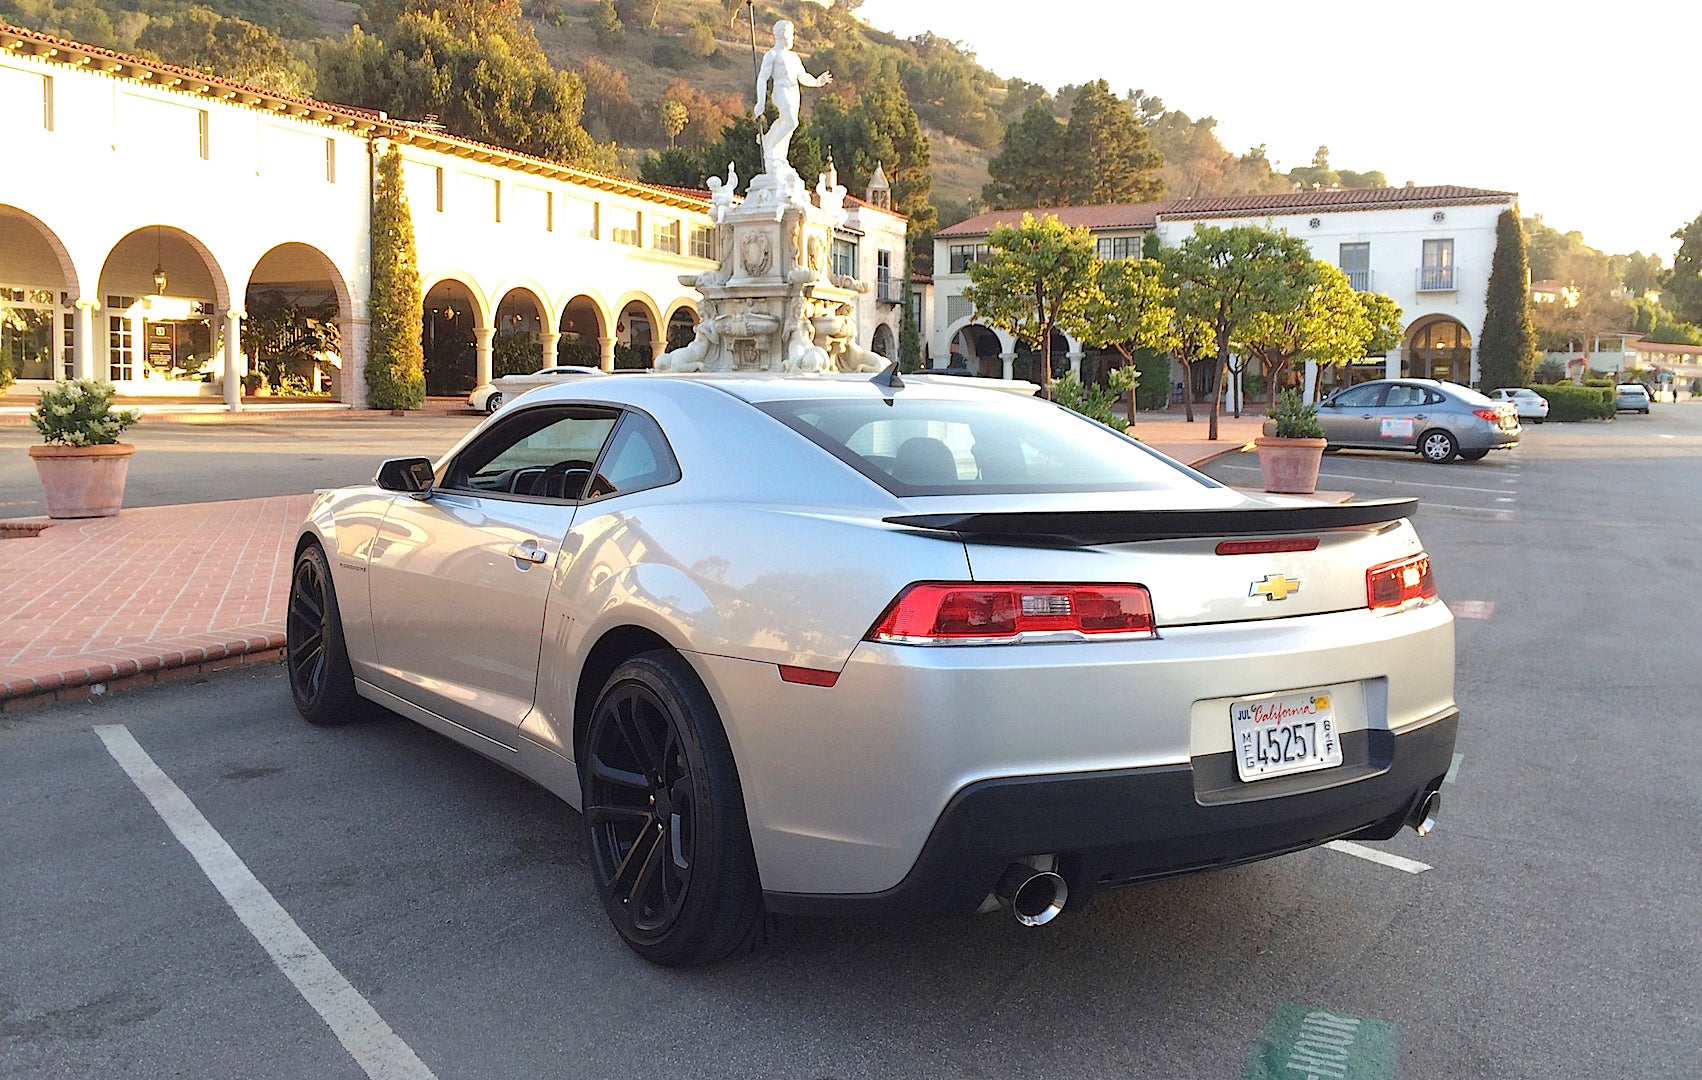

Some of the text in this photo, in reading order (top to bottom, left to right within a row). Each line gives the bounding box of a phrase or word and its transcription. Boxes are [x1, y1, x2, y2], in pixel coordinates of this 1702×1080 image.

[1238, 709, 1251, 721] JUL
[1254, 702, 1316, 725] California
[1257, 722, 1317, 765] 45257
